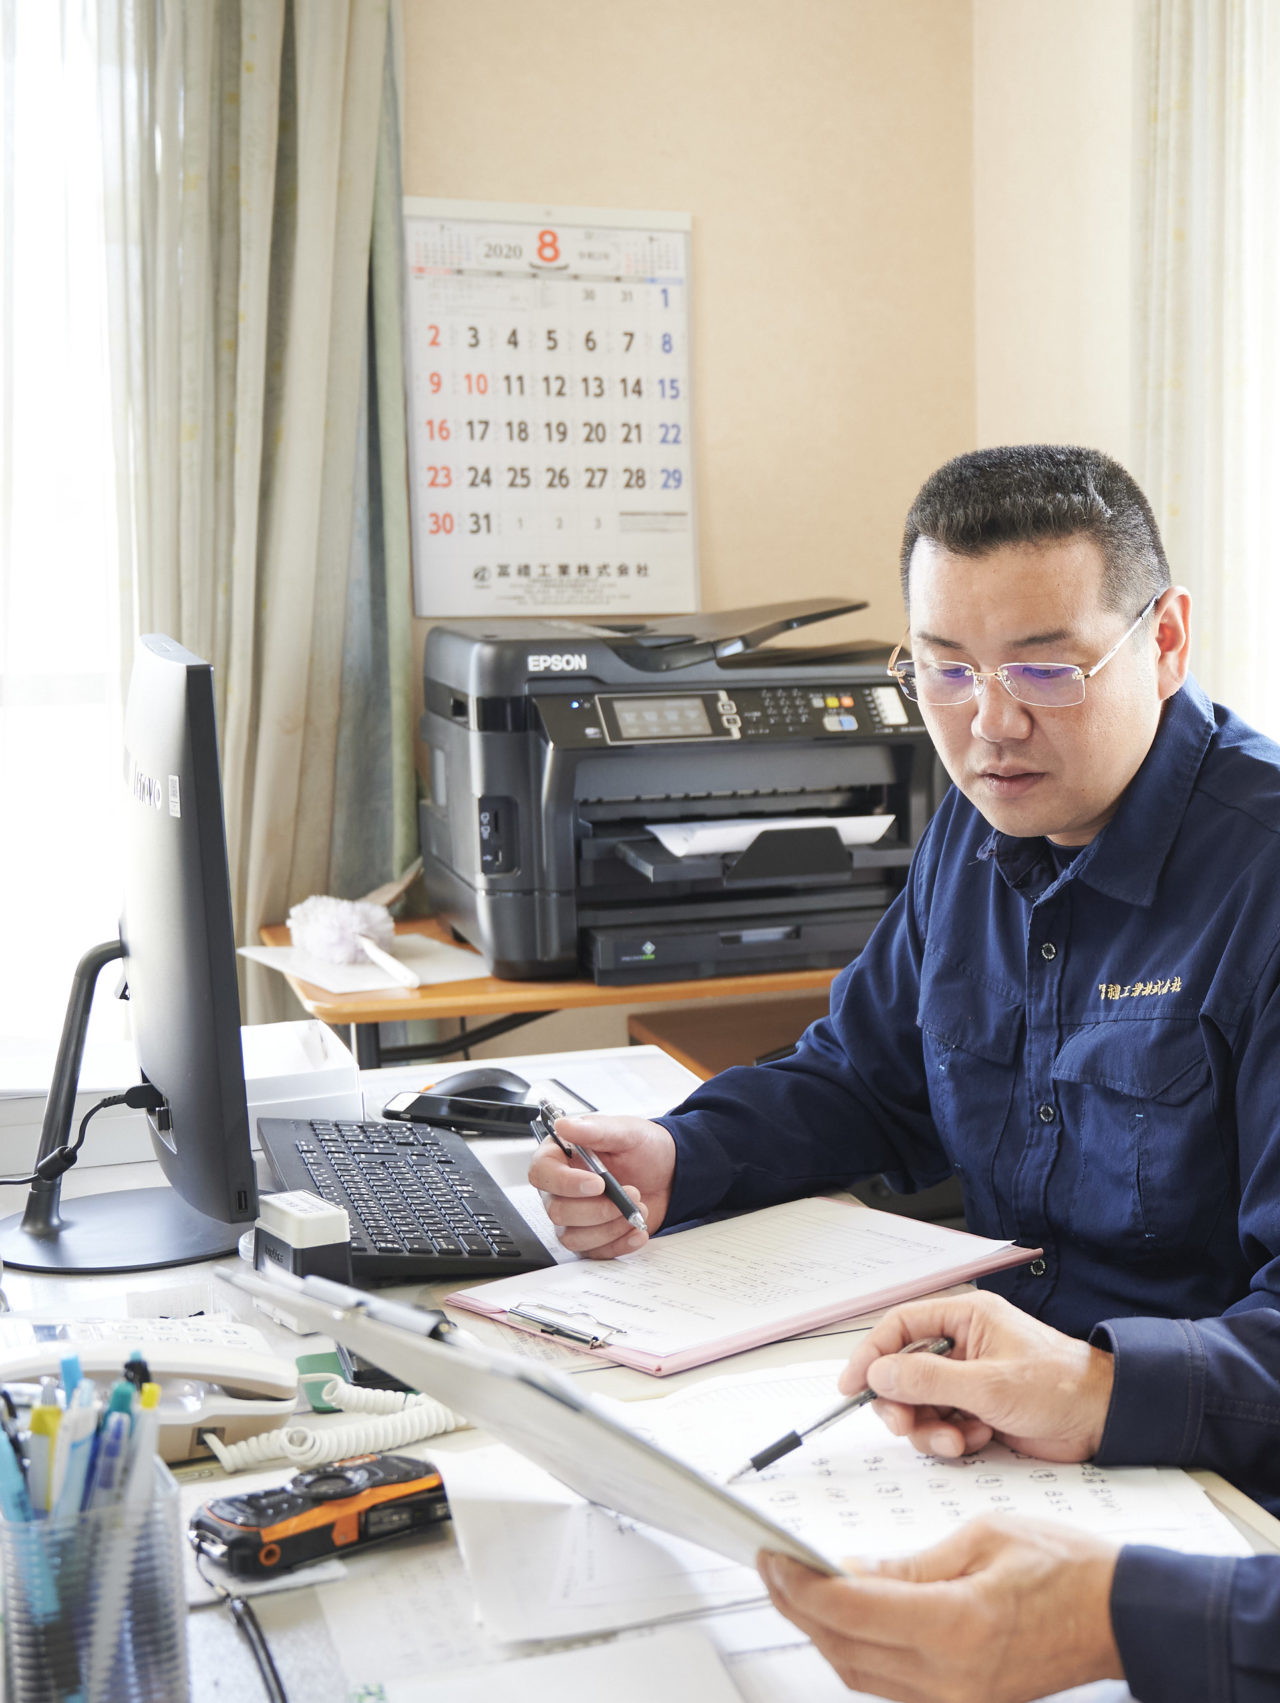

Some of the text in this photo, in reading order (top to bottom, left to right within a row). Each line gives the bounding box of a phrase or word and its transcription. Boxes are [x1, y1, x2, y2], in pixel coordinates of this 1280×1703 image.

[483, 242, 523, 260] 2020
[536, 229, 561, 263] 8
[660, 287, 669, 309] 1
[427, 324, 673, 354] 2 3 4 5 6 7 8
[429, 371, 680, 400] 9 10 11 12 13 14 15
[425, 419, 682, 445] 16 17 18 19 20 21 22
[426, 465, 683, 490] 23 24 25 26 27 28 29
[428, 512, 454, 535] 30
[469, 512, 492, 535] 31
[527, 653, 588, 672] EPSON
